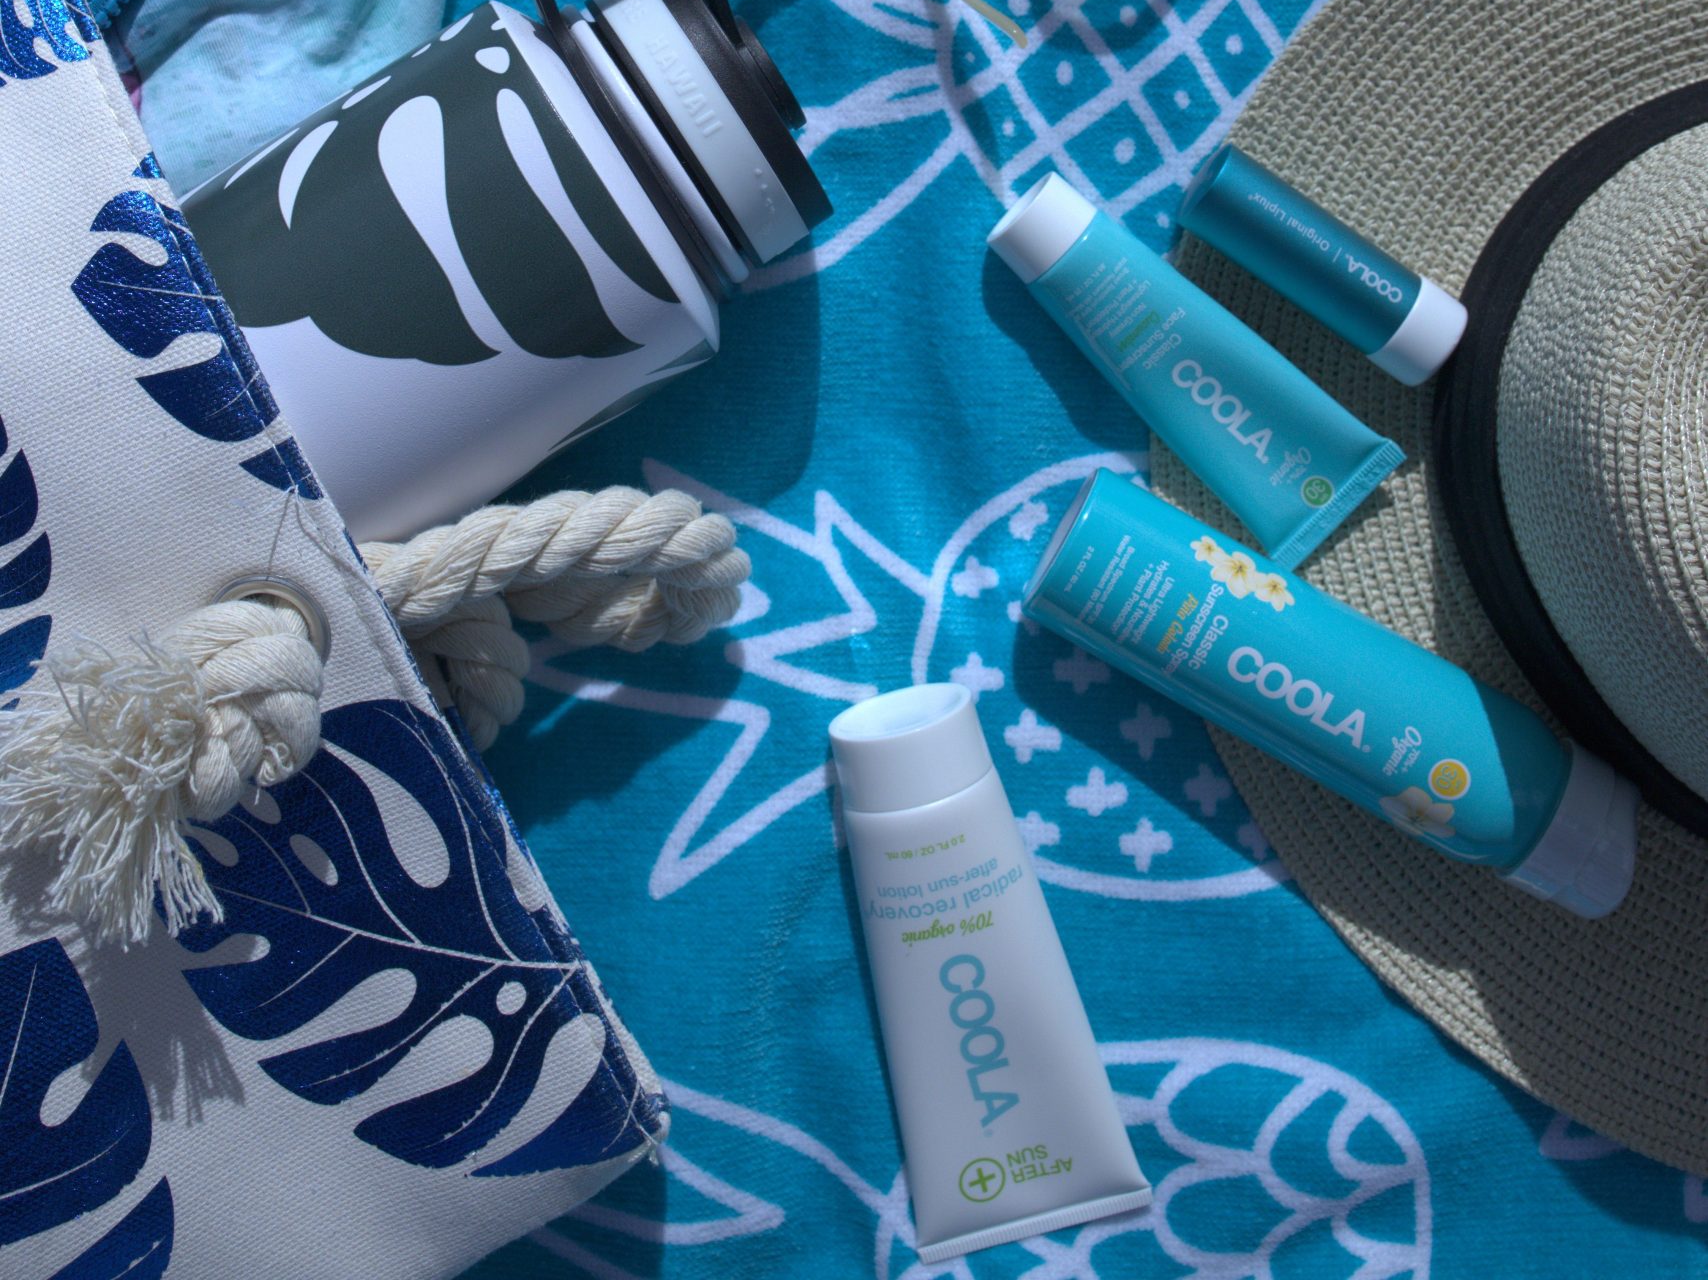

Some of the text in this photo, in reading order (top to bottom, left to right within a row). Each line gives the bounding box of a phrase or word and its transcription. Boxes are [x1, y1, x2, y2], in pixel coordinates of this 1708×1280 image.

[645, 32, 723, 138] HAWAII
[1285, 216, 1330, 250] Original
[1163, 307, 1186, 330] Face
[1142, 334, 1181, 369] Classic
[1306, 480, 1324, 499] 30
[1134, 569, 1152, 592] Plant
[1145, 560, 1170, 599] Hydrates
[1132, 575, 1175, 644] Ultra Lightweight
[1180, 582, 1224, 650] Sunscreen
[1188, 616, 1229, 670] Classic
[1383, 727, 1421, 776] Organic
[1436, 766, 1457, 789] 30
[919, 844, 934, 856] OZ
[877, 858, 998, 897] after-sun lotion
[962, 864, 1023, 908] radical
[901, 910, 993, 947] 70% organic
[1006, 1144, 1048, 1167] SUN
[1010, 1157, 1072, 1183] AFTER
